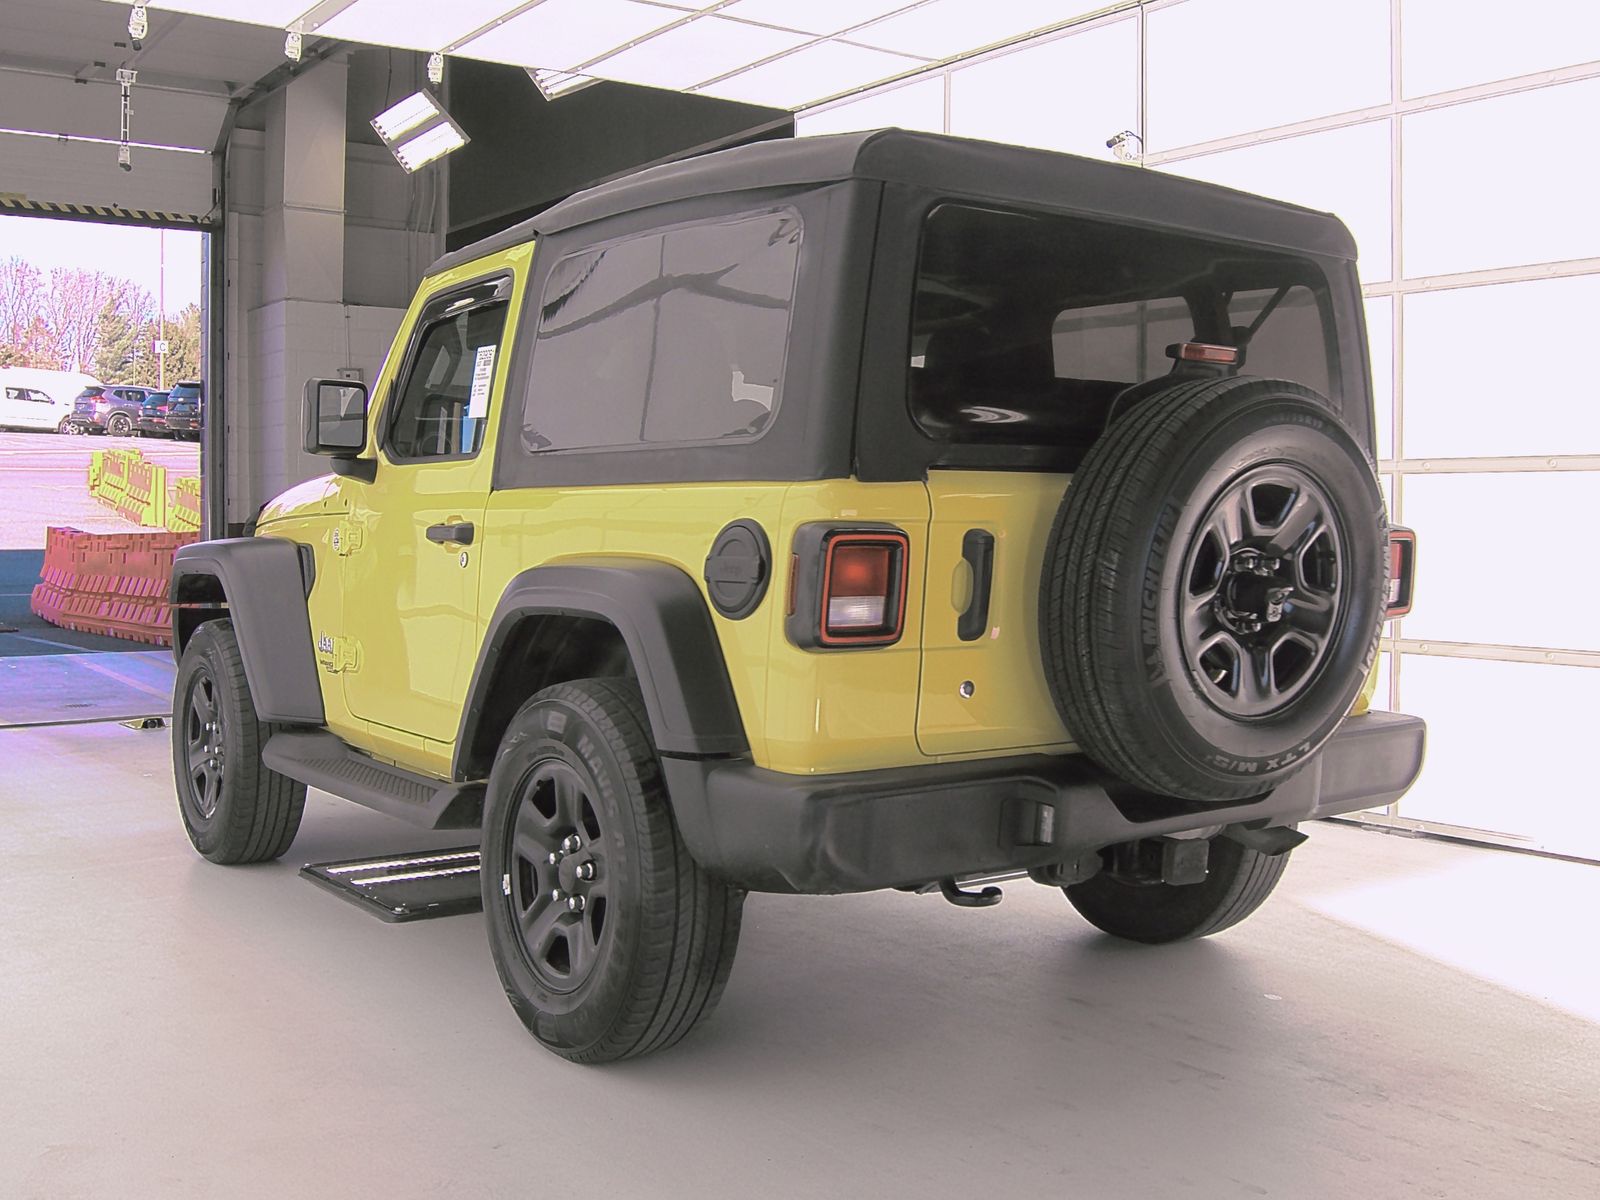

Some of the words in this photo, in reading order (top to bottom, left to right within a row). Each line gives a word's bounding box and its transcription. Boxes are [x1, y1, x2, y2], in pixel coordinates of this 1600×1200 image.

[159, 342, 166, 352] C
[1142, 503, 1180, 645] MICHELIN
[577, 734, 620, 819] MAVIS
[1266, 741, 1311, 771] LTX
